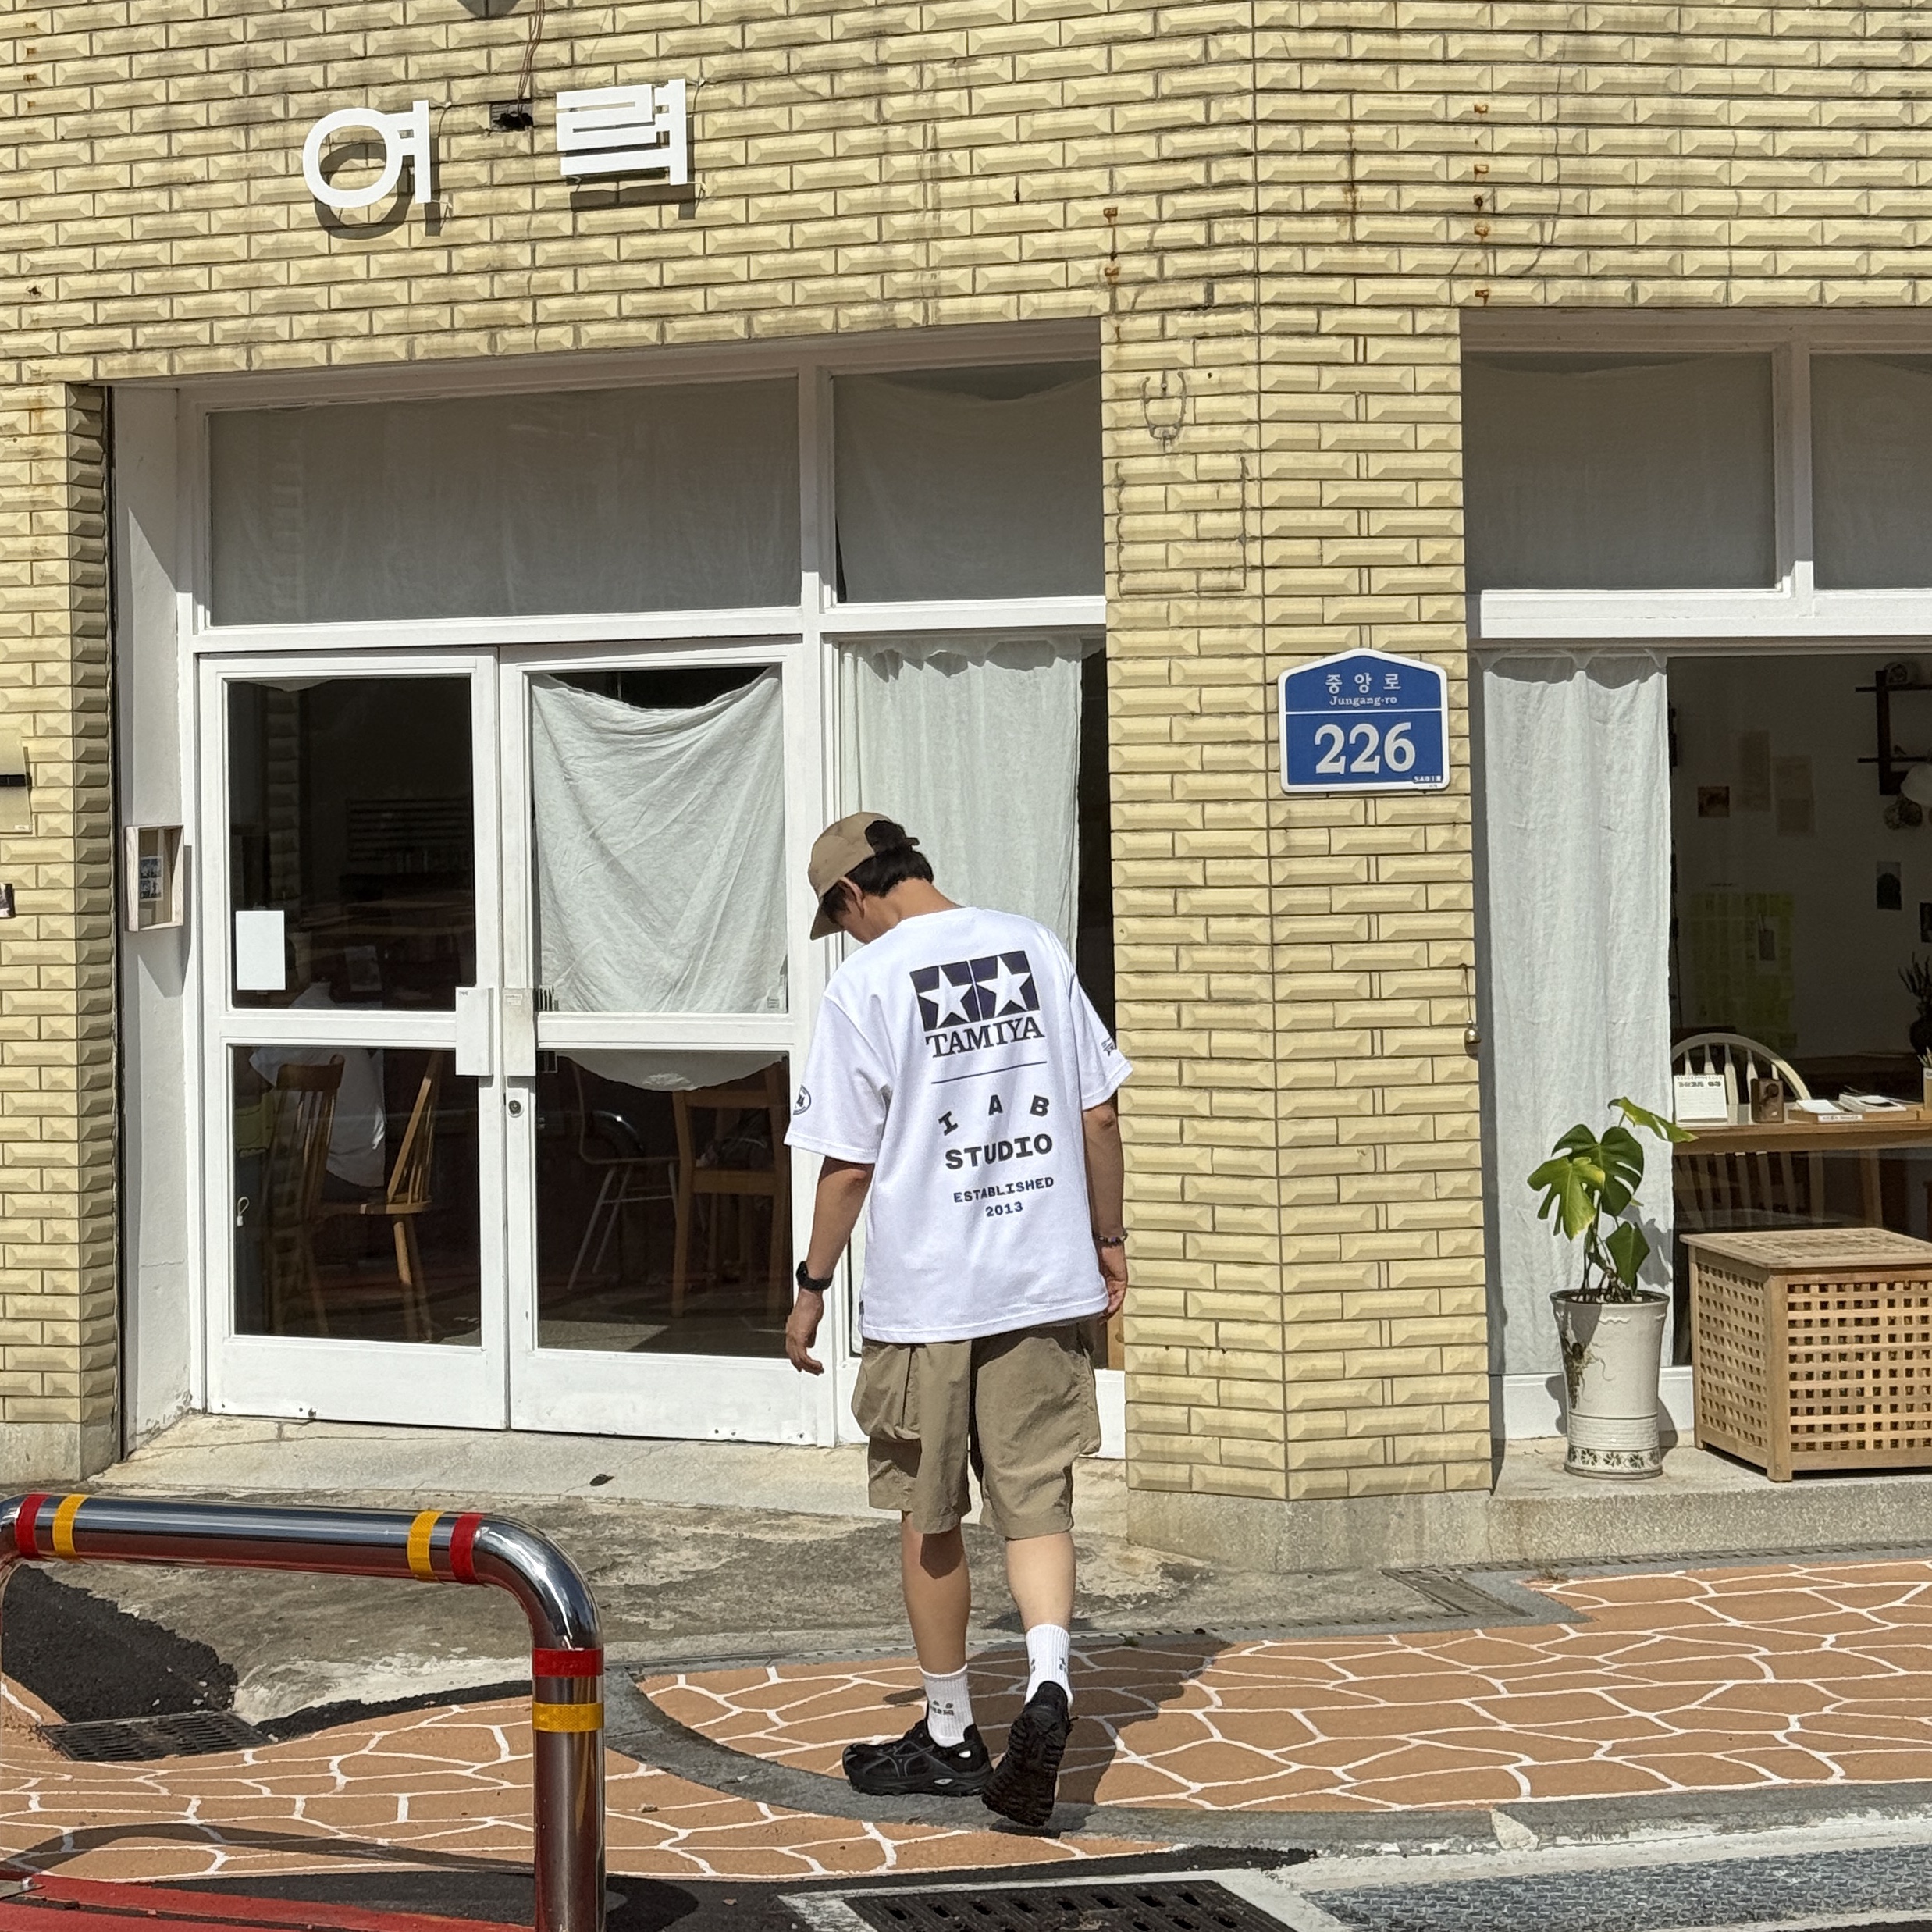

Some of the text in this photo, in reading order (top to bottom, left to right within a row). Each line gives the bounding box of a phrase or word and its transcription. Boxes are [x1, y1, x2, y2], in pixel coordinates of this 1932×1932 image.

[1325, 672, 1402, 695] 중앙로
[1329, 696, 1397, 707] Jungang-ro
[1314, 721, 1416, 775] 226
[925, 1016, 1045, 1059] TAMIYA
[945, 1133, 1053, 1170] STUDIO
[953, 1176, 1055, 1203] ESTABLISHED
[985, 1201, 1023, 1217] 2013
